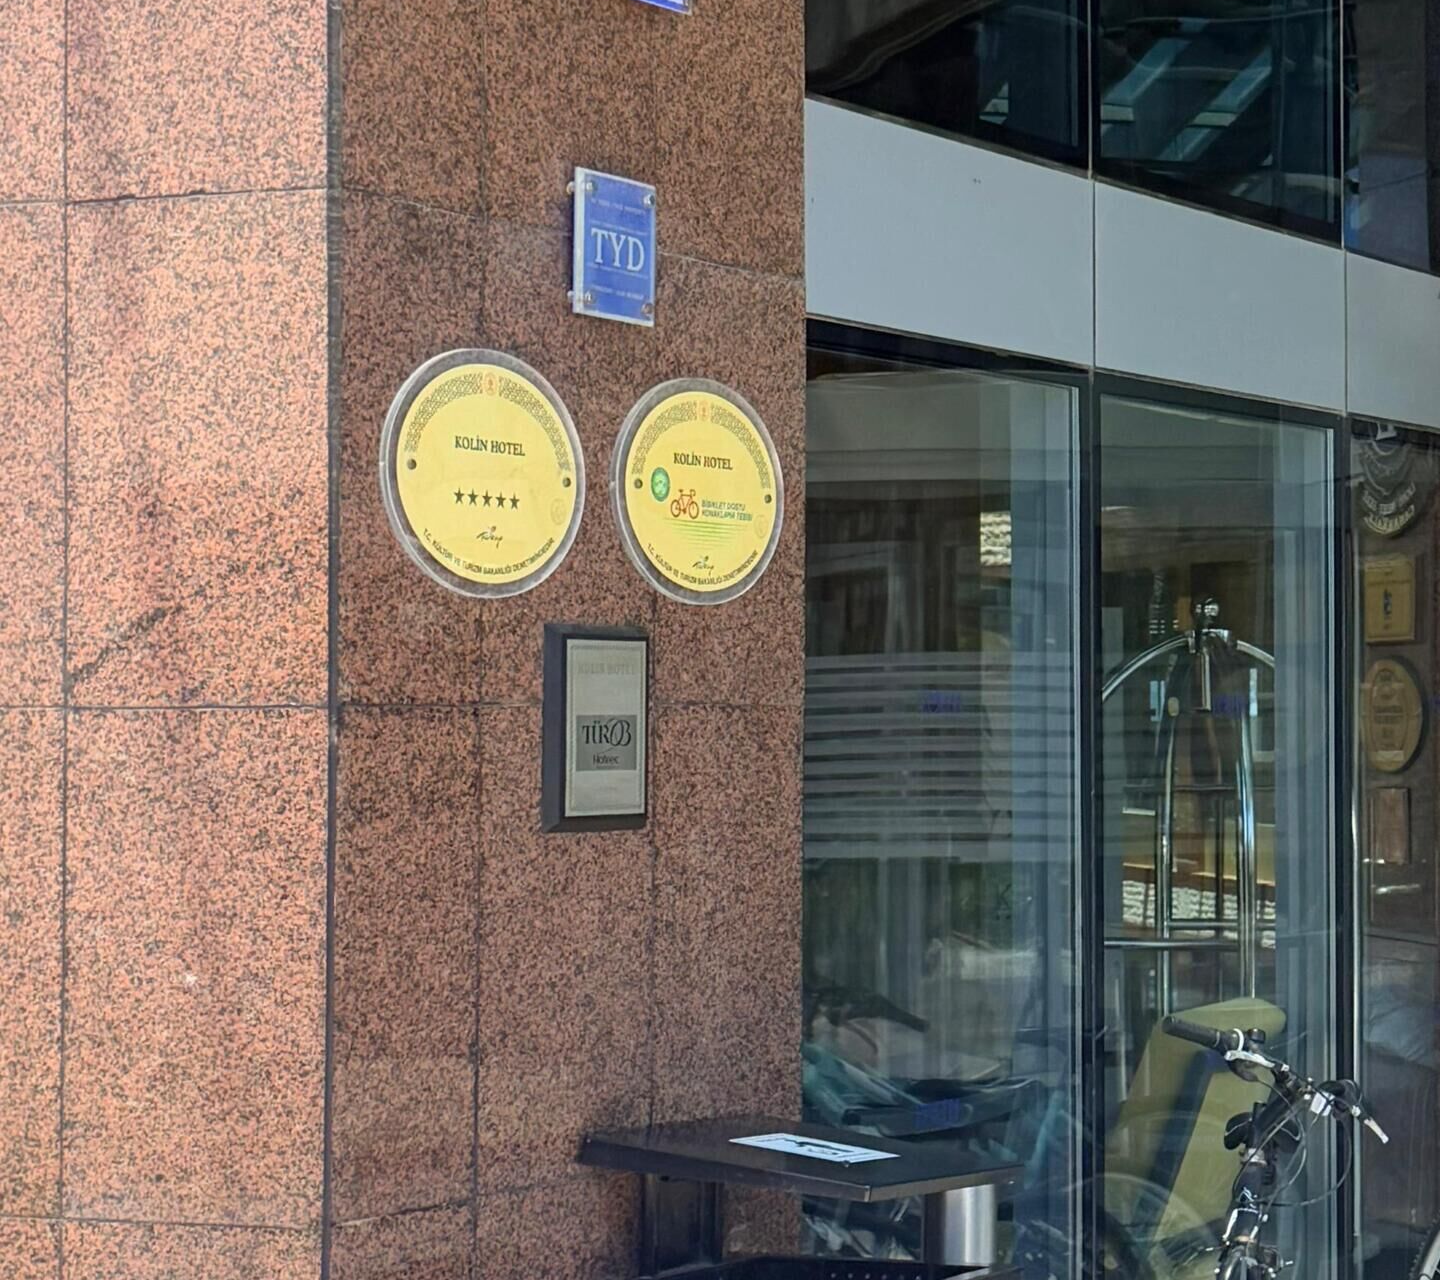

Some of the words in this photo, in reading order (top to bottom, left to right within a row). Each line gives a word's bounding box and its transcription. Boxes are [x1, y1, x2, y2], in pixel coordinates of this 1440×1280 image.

[591, 227, 645, 271] TYD
[454, 435, 488, 453] KOLİN
[490, 438, 526, 457] HOTEL
[673, 451, 701, 467] KOLİN
[703, 455, 733, 471] HOTEL
